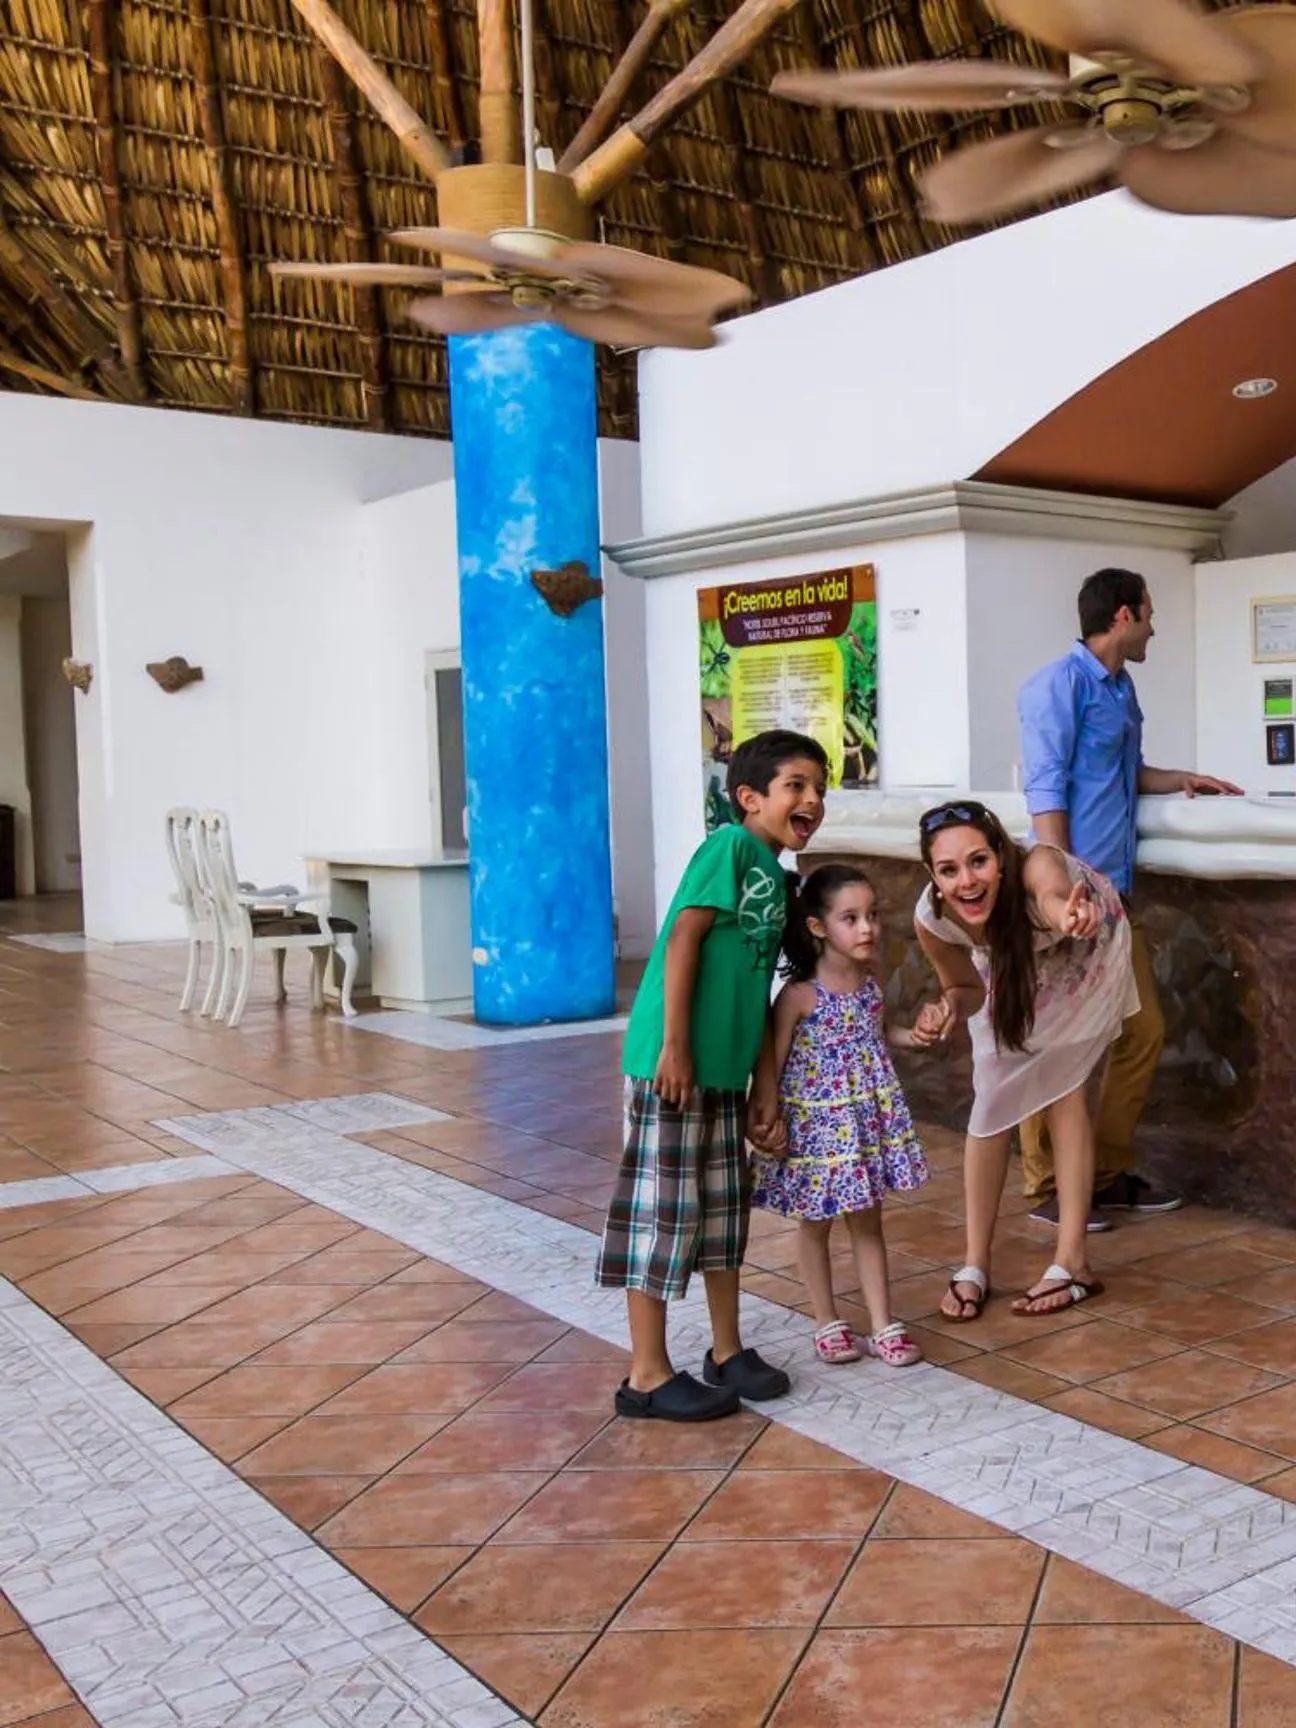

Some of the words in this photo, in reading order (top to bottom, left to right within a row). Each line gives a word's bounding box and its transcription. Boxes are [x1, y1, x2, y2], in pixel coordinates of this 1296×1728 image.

[724, 591, 782, 619] ¡Creemos
[785, 588, 801, 607] en
[803, 580, 815, 604] la
[817, 575, 848, 602] vida!
